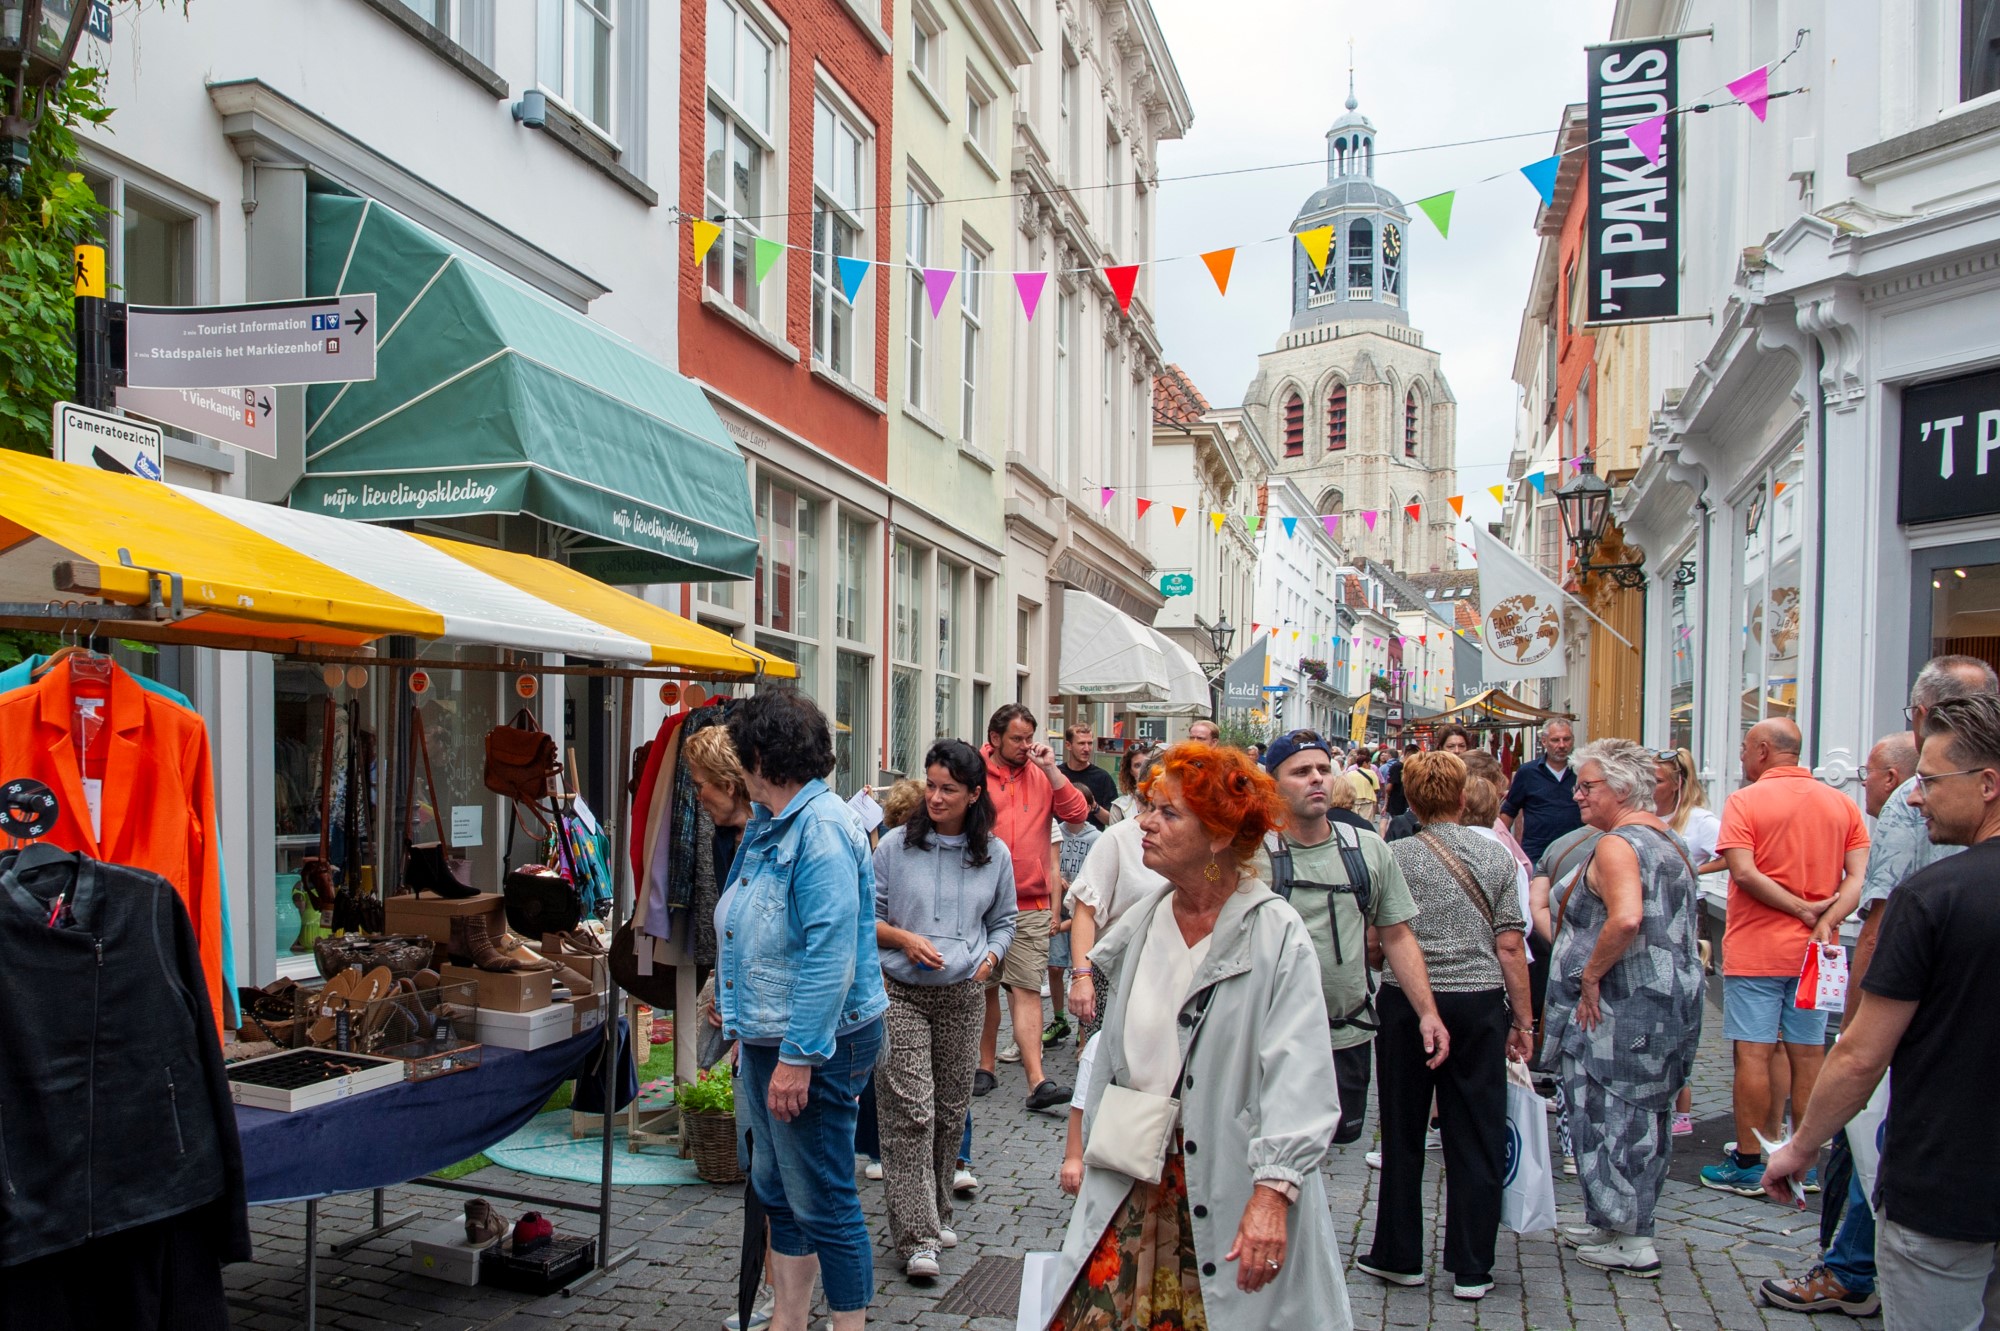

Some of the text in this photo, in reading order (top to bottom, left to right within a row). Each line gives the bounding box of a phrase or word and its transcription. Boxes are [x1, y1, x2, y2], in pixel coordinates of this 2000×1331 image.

[1600, 48, 1668, 254] PAKHUIS
[197, 322, 237, 336] Tourist
[239, 319, 307, 333] Information
[151, 347, 222, 361] Stadspaleis
[225, 344, 243, 357] het
[246, 340, 323, 356] Markiezenhof
[189, 390, 242, 422] Vierkantje
[68, 415, 156, 448] Cameratoezicht
[323, 478, 498, 513] mijn lievelingskleding
[633, 509, 699, 556] lievelingskleding
[1492, 614, 1516, 630] FAIR
[1498, 629, 1553, 649] BERGEN OP ZOOM
[1228, 681, 1260, 697] kaldi
[8, 783, 22, 794] 36
